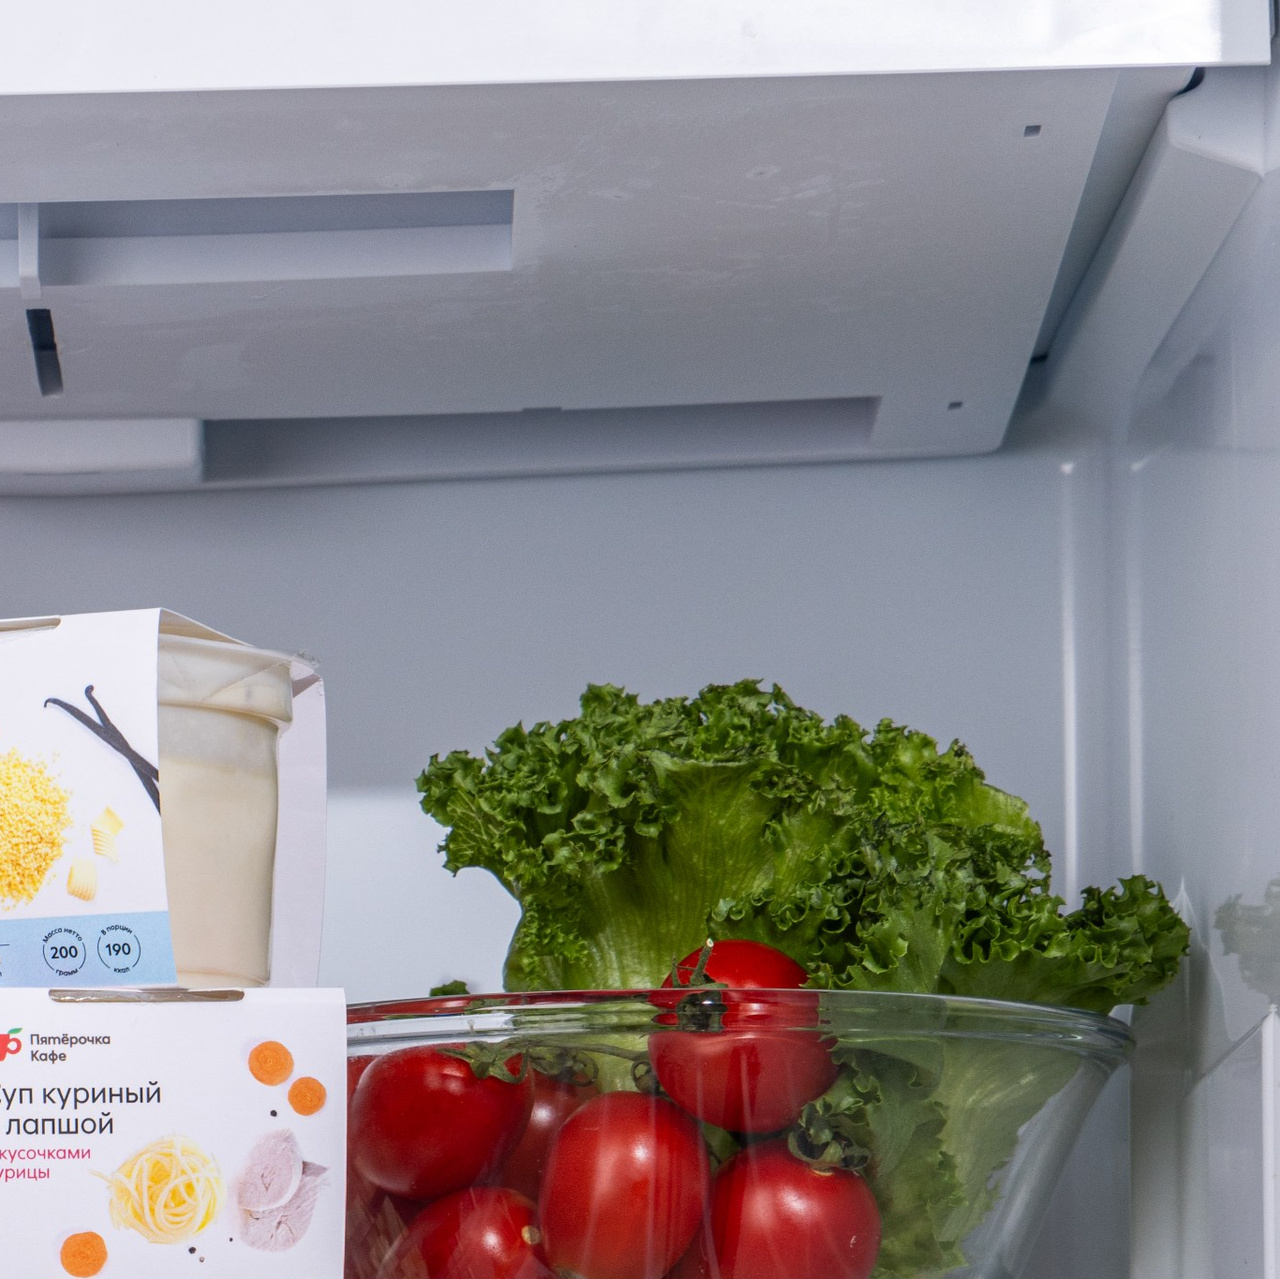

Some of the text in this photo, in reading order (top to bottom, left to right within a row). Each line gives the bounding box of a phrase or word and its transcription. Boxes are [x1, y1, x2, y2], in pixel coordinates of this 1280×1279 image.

[42, 928, 82, 943] Масса нетто
[106, 925, 133, 935] порции
[51, 946, 78, 959] 200
[106, 943, 131, 956] 190
[30, 1032, 111, 1048] Пятёрочка
[30, 1050, 67, 1064] Кафе
[42, 1080, 162, 1110] куриный
[6, 1112, 114, 1135] лапшой
